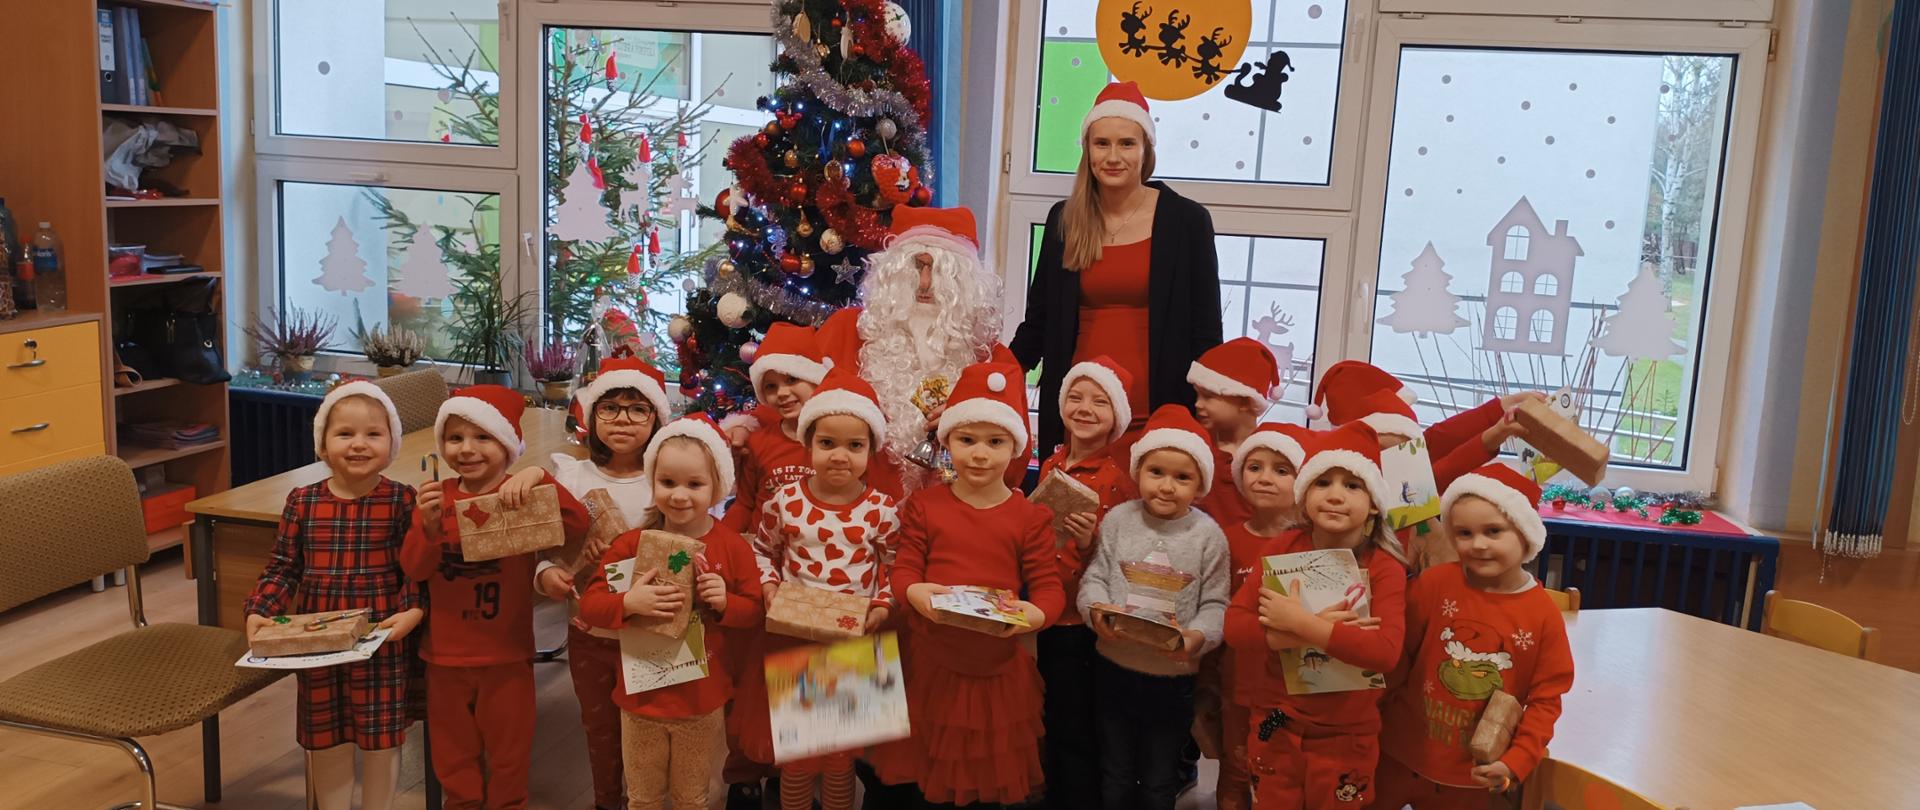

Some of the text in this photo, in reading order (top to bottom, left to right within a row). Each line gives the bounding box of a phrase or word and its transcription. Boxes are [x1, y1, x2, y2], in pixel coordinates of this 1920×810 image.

[773, 467, 782, 475] IS
[798, 466, 816, 475] TOO
[474, 582, 500, 620] 19
